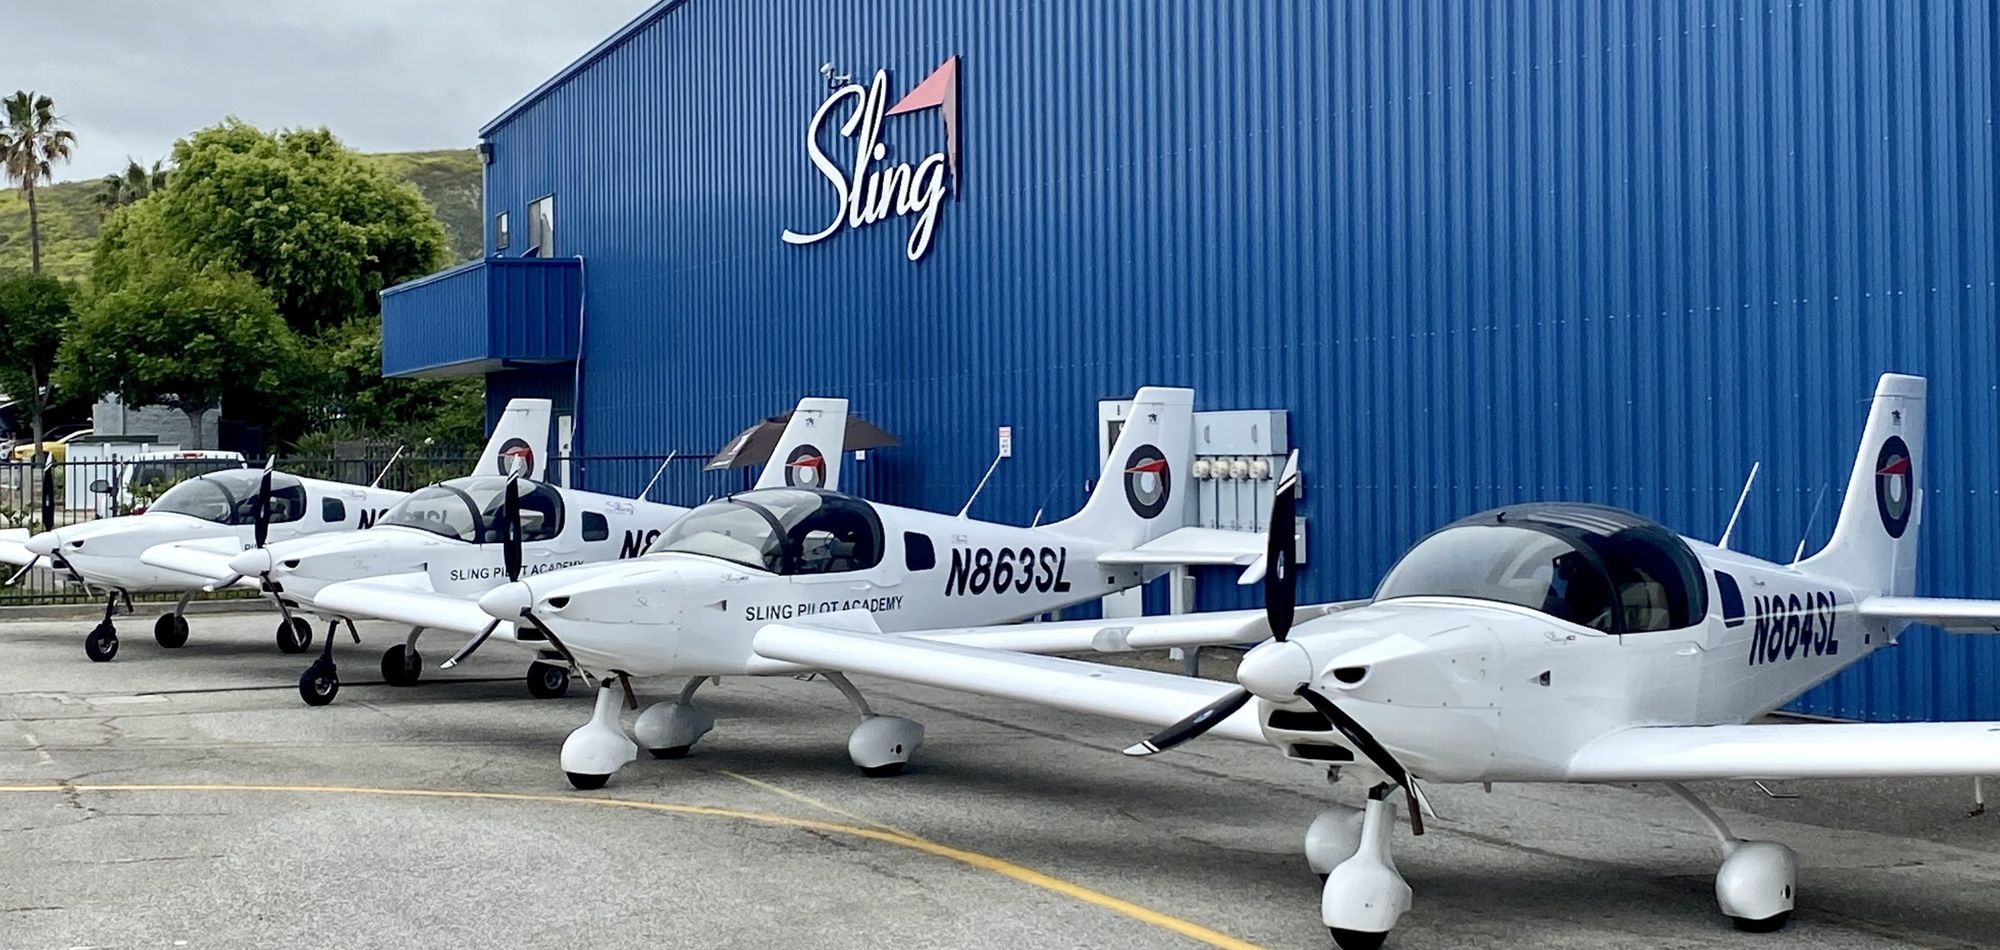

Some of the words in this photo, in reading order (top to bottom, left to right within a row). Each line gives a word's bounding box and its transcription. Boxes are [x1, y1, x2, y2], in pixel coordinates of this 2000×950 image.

[781, 68, 945, 261] Sling
[450, 567, 490, 581] SLING
[944, 546, 1071, 597] N863SL
[745, 604, 793, 621] SLING
[841, 595, 903, 613] ACADEMY
[1749, 590, 1839, 666] N864SL
